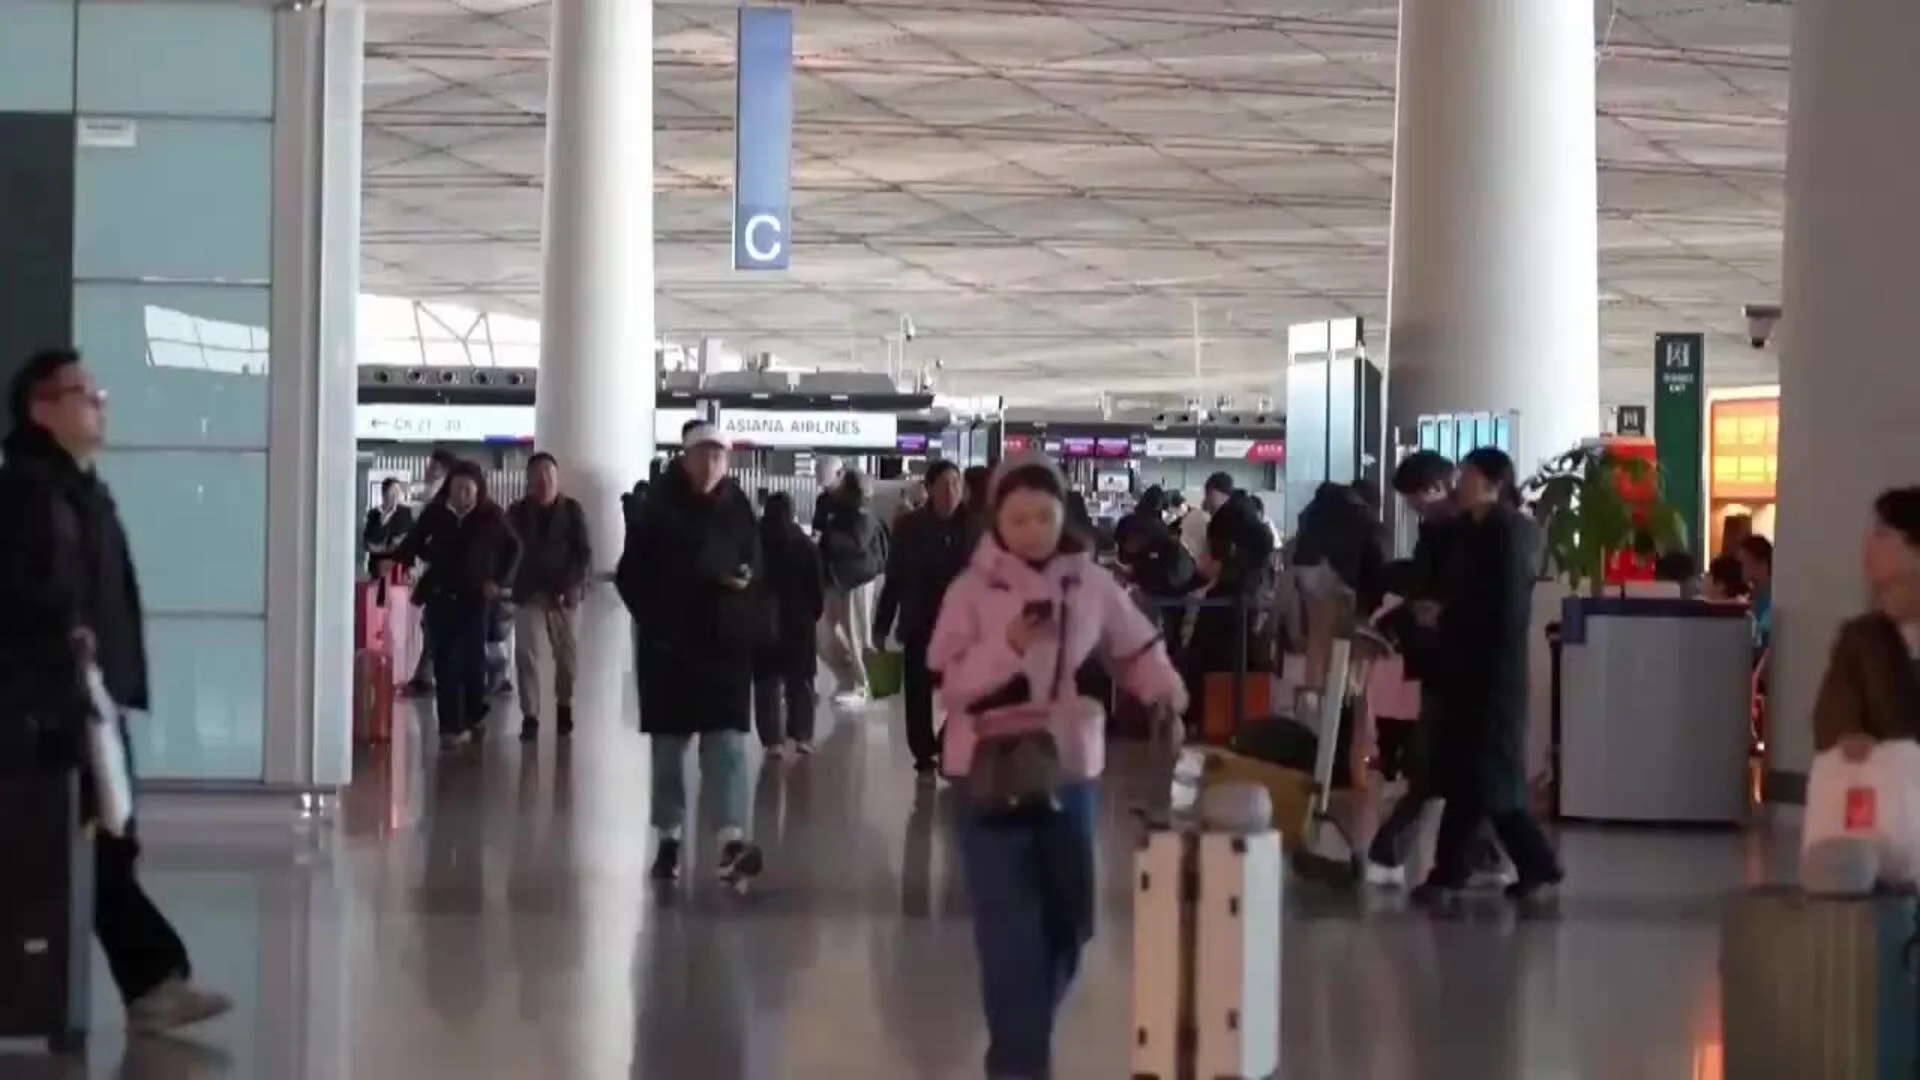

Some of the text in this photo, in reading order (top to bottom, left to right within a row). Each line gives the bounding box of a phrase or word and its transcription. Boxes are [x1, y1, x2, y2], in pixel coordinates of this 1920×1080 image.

[745, 214, 781, 261] C
[725, 419, 862, 435] ASIANA AIRLINES
